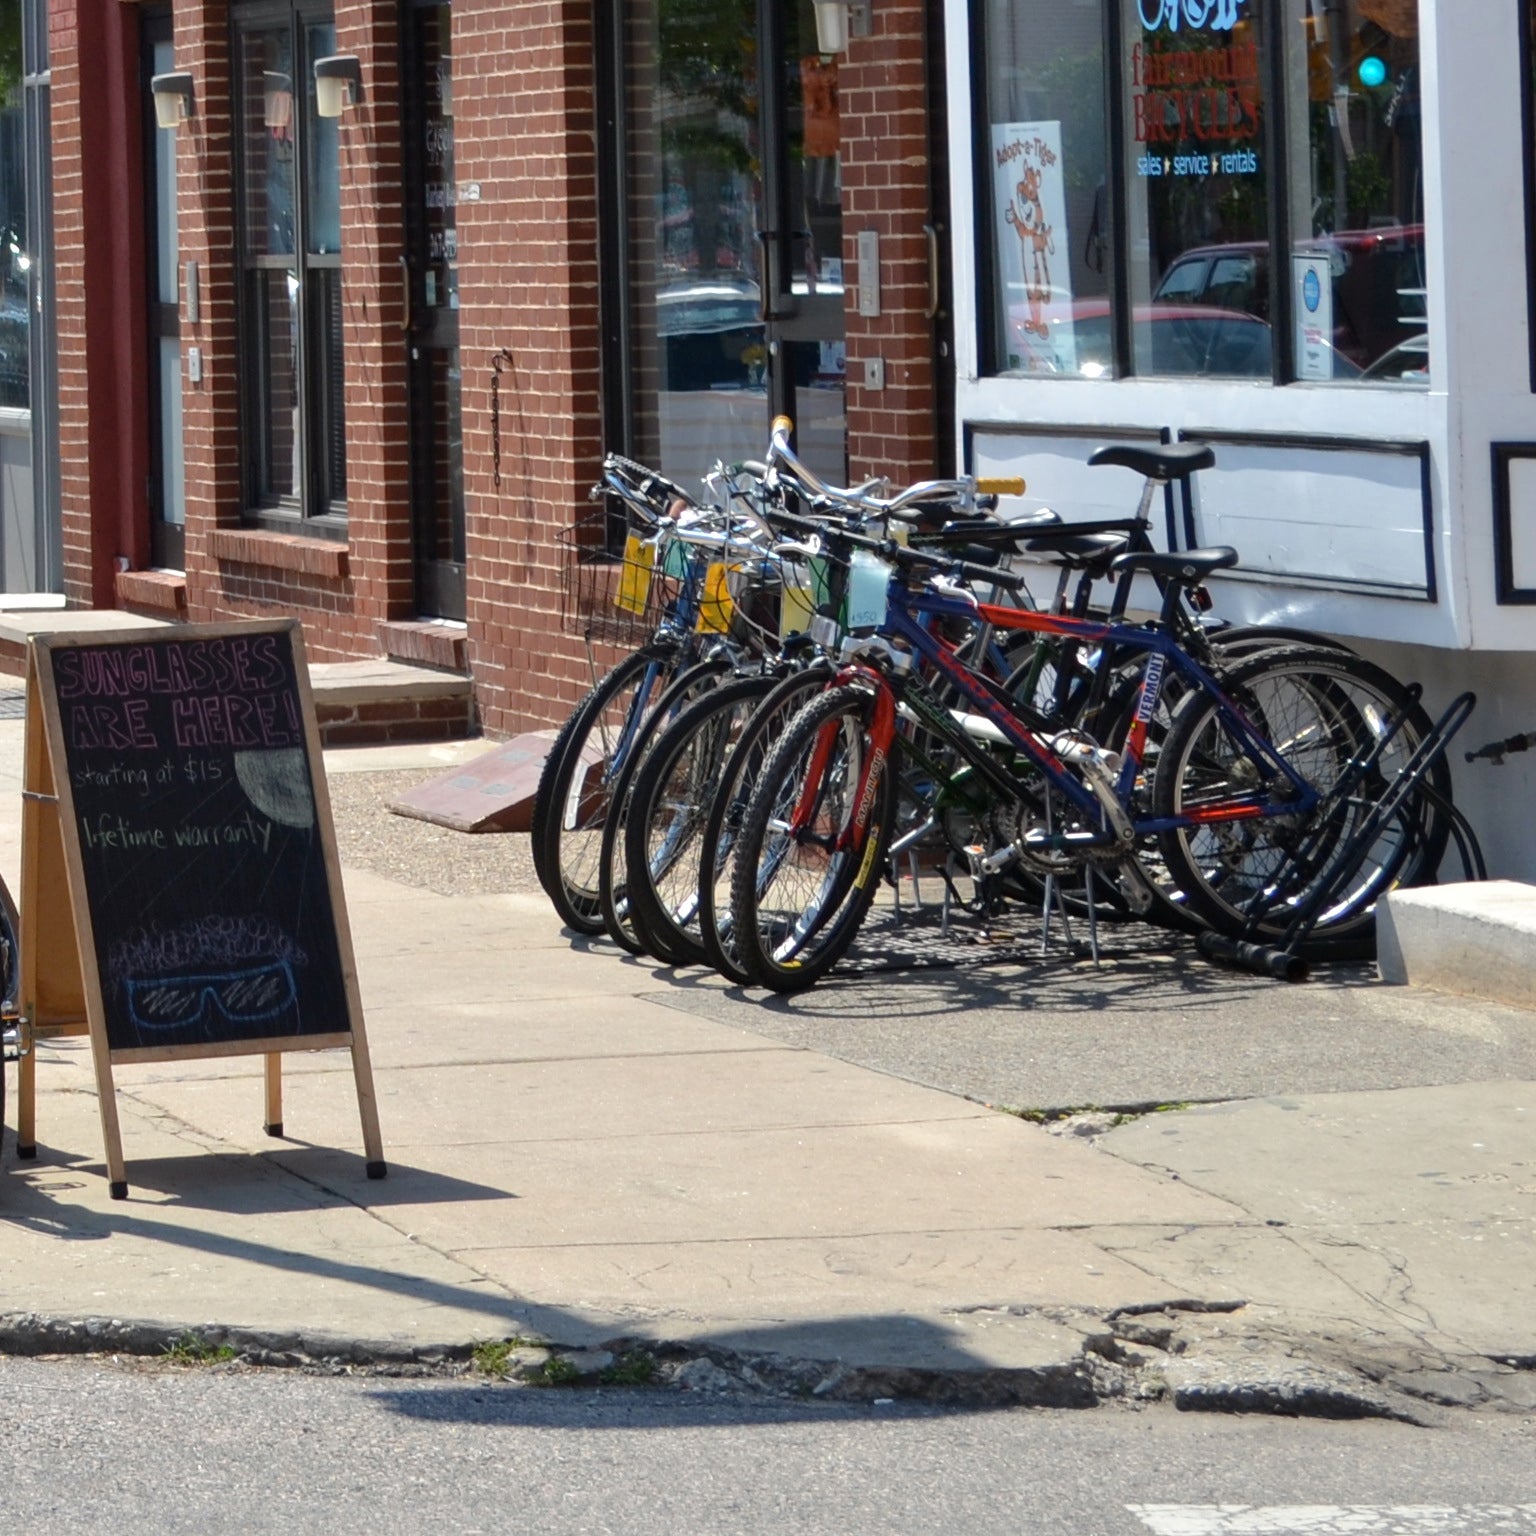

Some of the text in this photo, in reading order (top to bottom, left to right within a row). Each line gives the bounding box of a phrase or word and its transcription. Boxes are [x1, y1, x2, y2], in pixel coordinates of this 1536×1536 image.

[1132, 40, 1257, 86] fairmount
[1136, 147, 1257, 176] sales service rentals
[59, 636, 286, 698] SUNGLASSES
[1138, 654, 1165, 721] VERMONT
[72, 689, 302, 749] ARE HERE!
[75, 754, 223, 797] starting at $15
[174, 811, 272, 854] warranty
